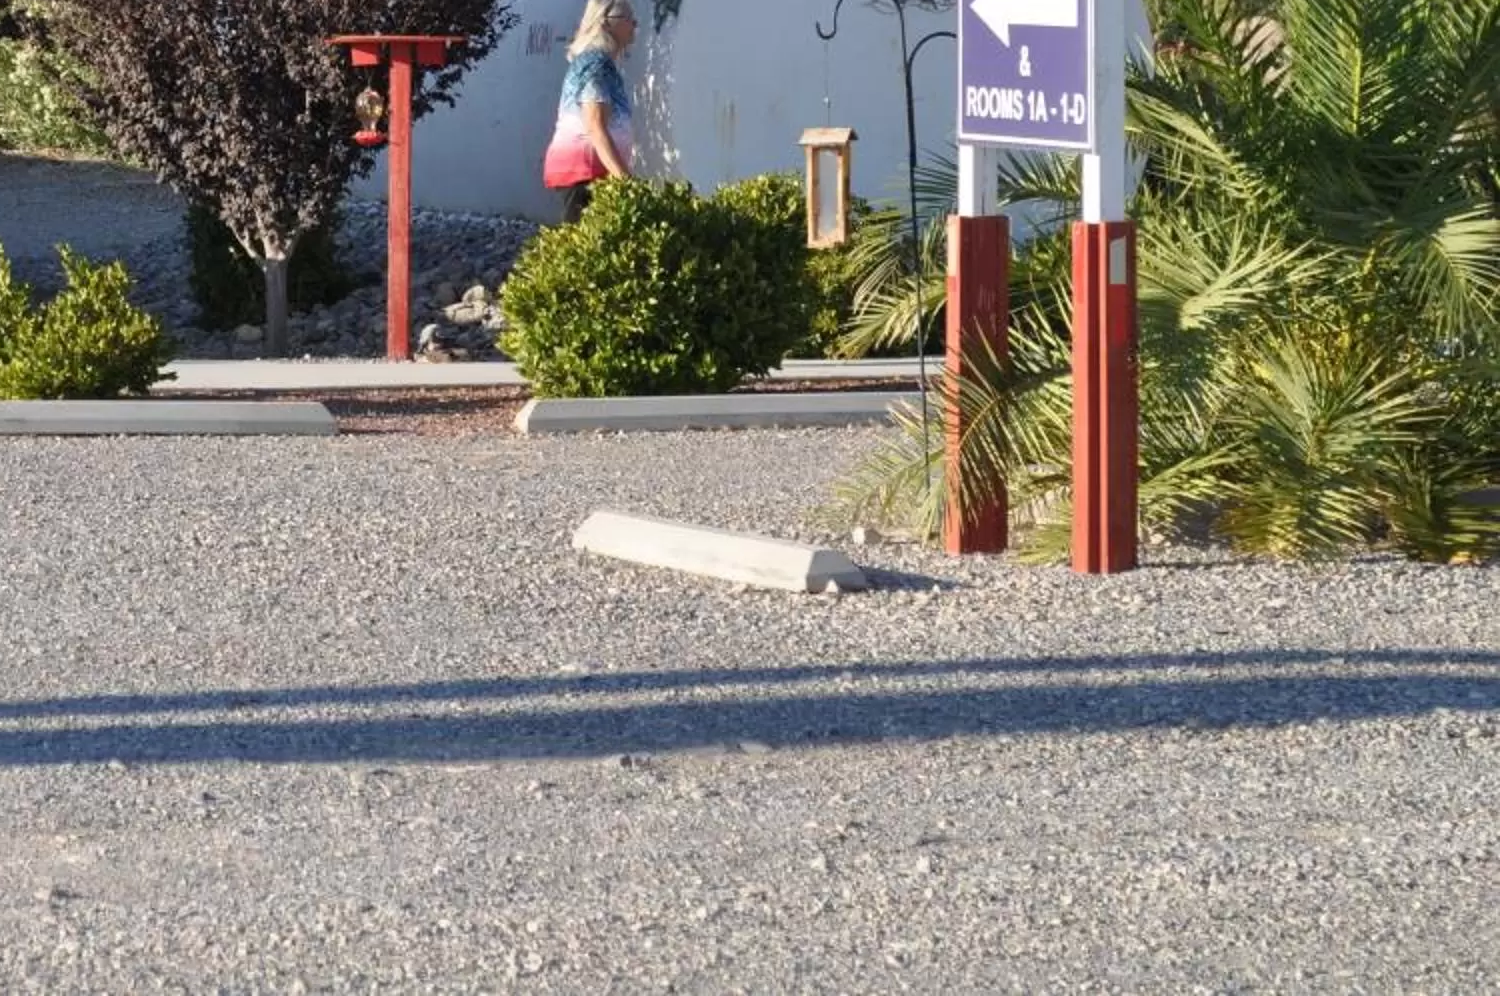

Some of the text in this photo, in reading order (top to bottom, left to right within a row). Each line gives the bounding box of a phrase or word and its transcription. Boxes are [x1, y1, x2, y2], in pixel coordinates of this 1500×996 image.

[1019, 45, 1031, 77] &
[966, 86, 1024, 121] ROOMS
[1027, 89, 1048, 123] 1A
